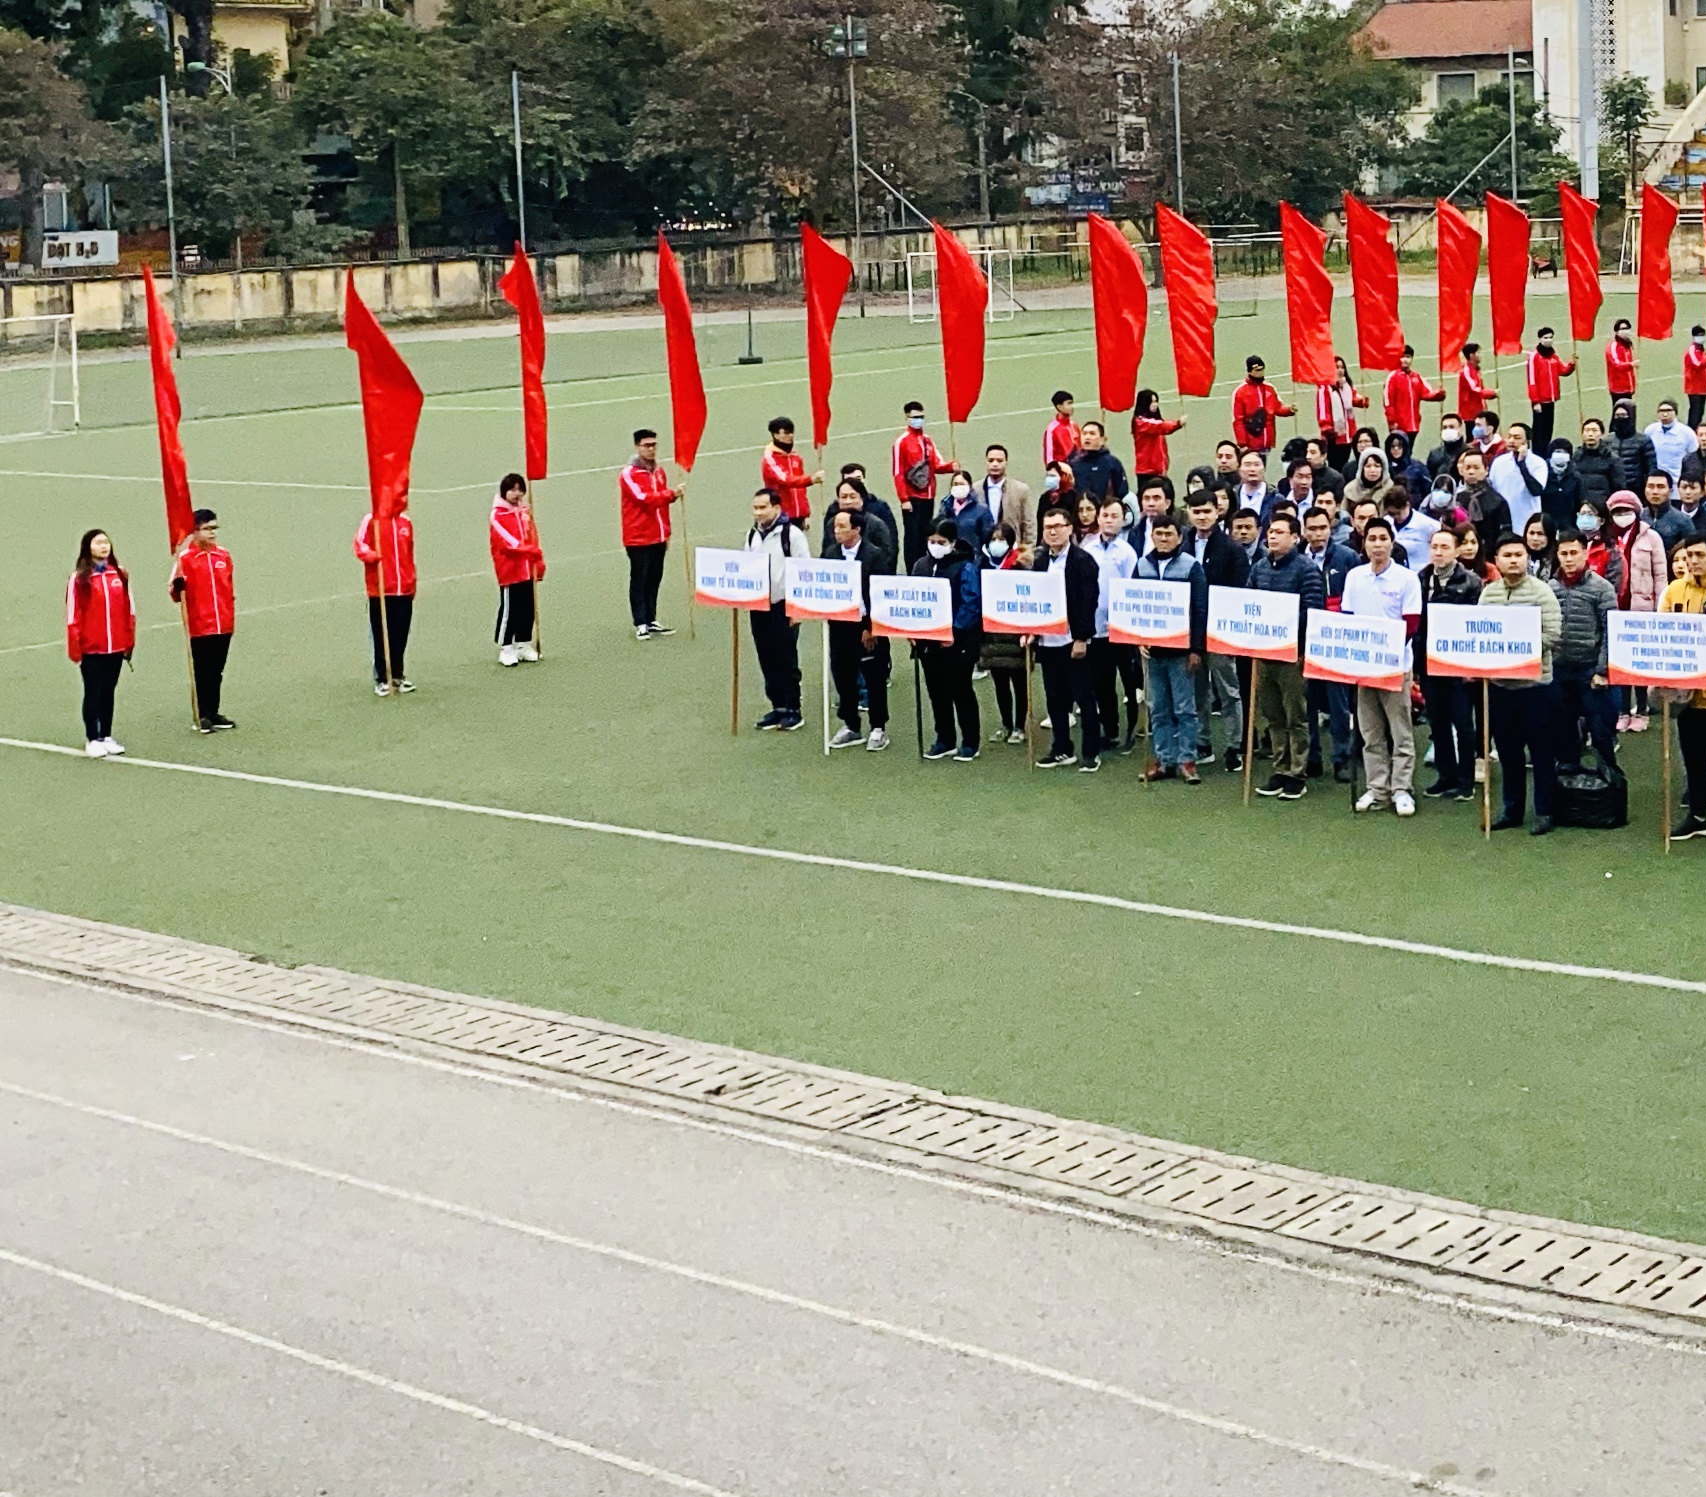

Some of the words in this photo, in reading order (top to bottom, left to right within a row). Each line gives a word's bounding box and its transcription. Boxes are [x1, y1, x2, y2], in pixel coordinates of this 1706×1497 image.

[1016, 583, 1030, 597] VIỆN
[1244, 603, 1261, 619] VIỆN
[1272, 625, 1288, 640] HỌC
[1466, 617, 1502, 633] TRƯỜNG
[1452, 636, 1476, 653] NGHỀ
[1479, 639, 1504, 654] BÁCH
[1507, 641, 1532, 654] KHOA
